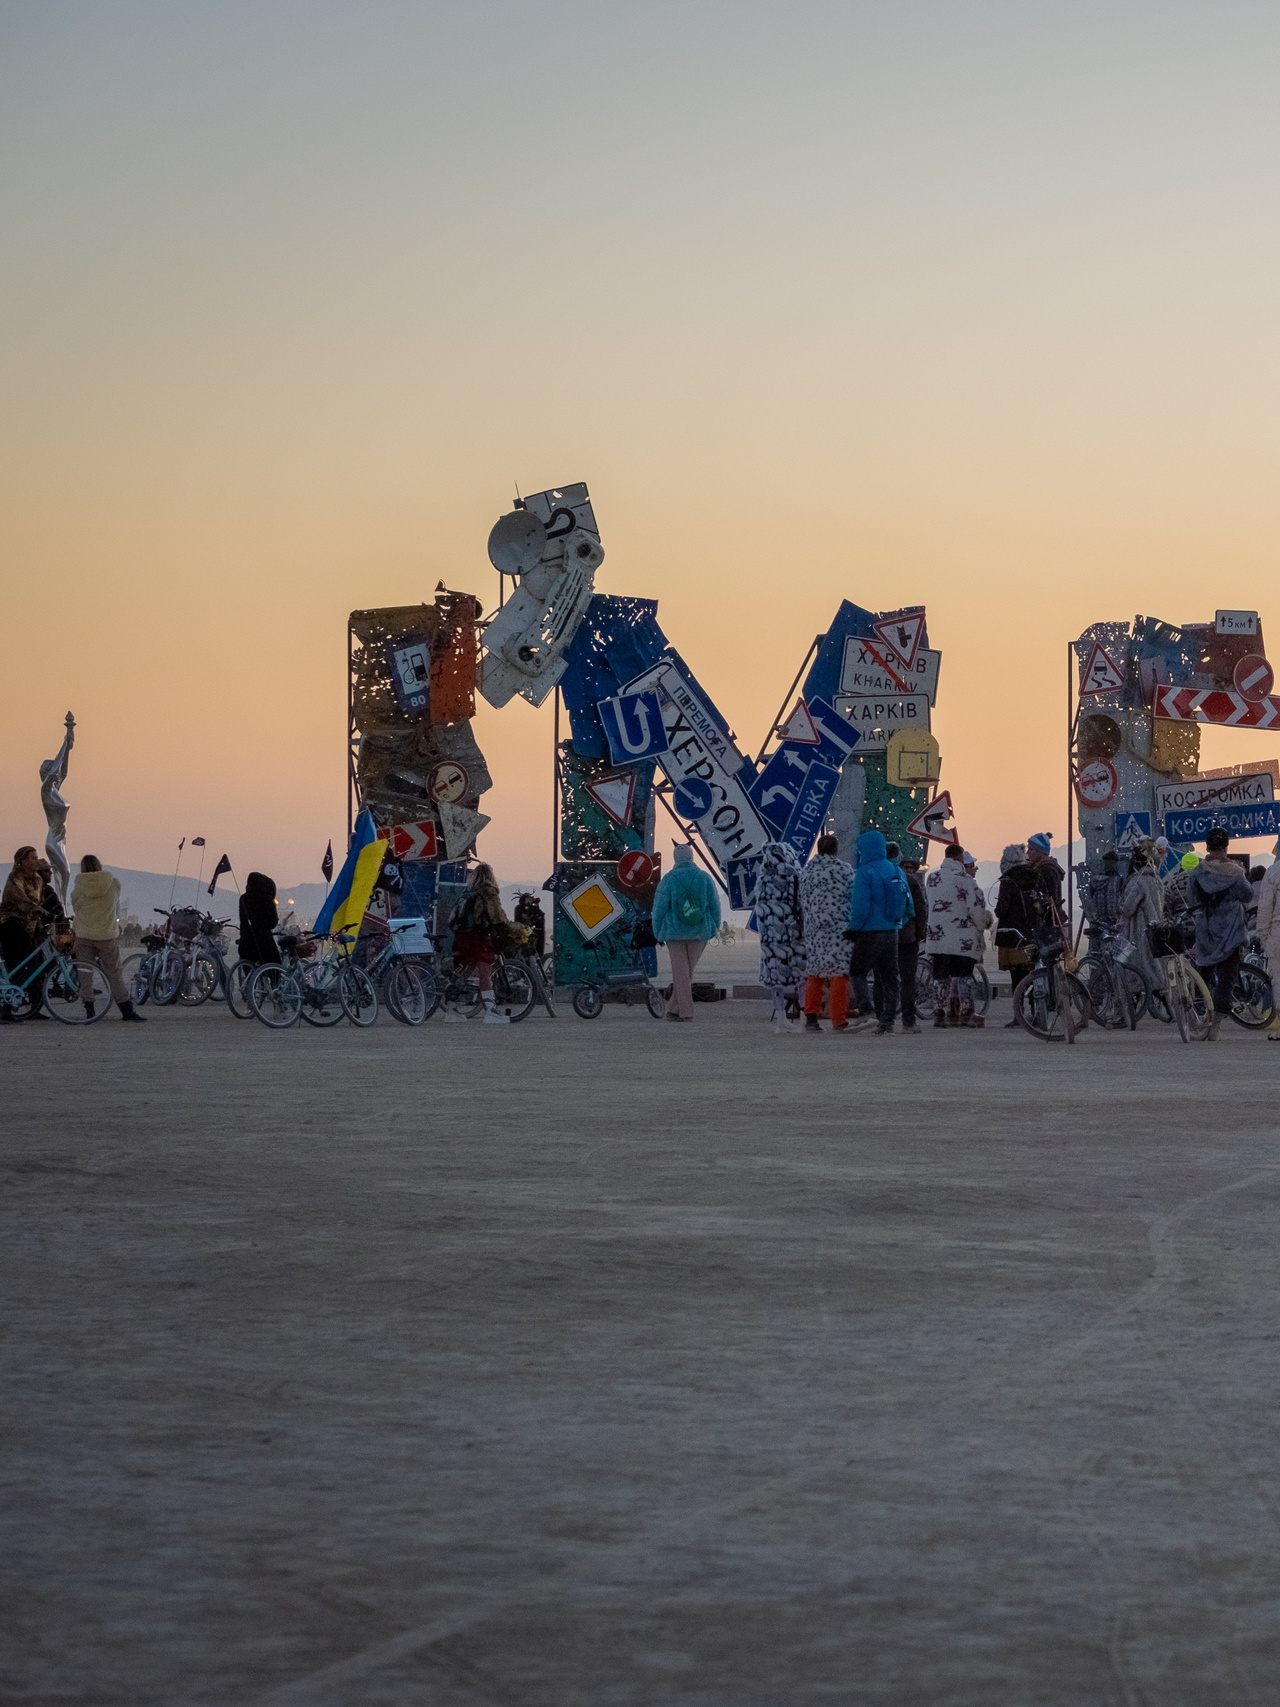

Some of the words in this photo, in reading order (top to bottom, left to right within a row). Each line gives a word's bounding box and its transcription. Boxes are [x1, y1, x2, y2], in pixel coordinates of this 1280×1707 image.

[856, 648, 927, 674] ХАРВ
[853, 673, 918, 692] KHARKV
[410, 695, 426, 707] 80
[847, 702, 917, 721] ХАРКІВ
[672, 686, 728, 759] ПЕРЕМОГА
[1161, 784, 1266, 808] КОСТРОМКА
[791, 778, 830, 849] АТІВКА
[1171, 811, 1276, 835] КОСТРОМКА
